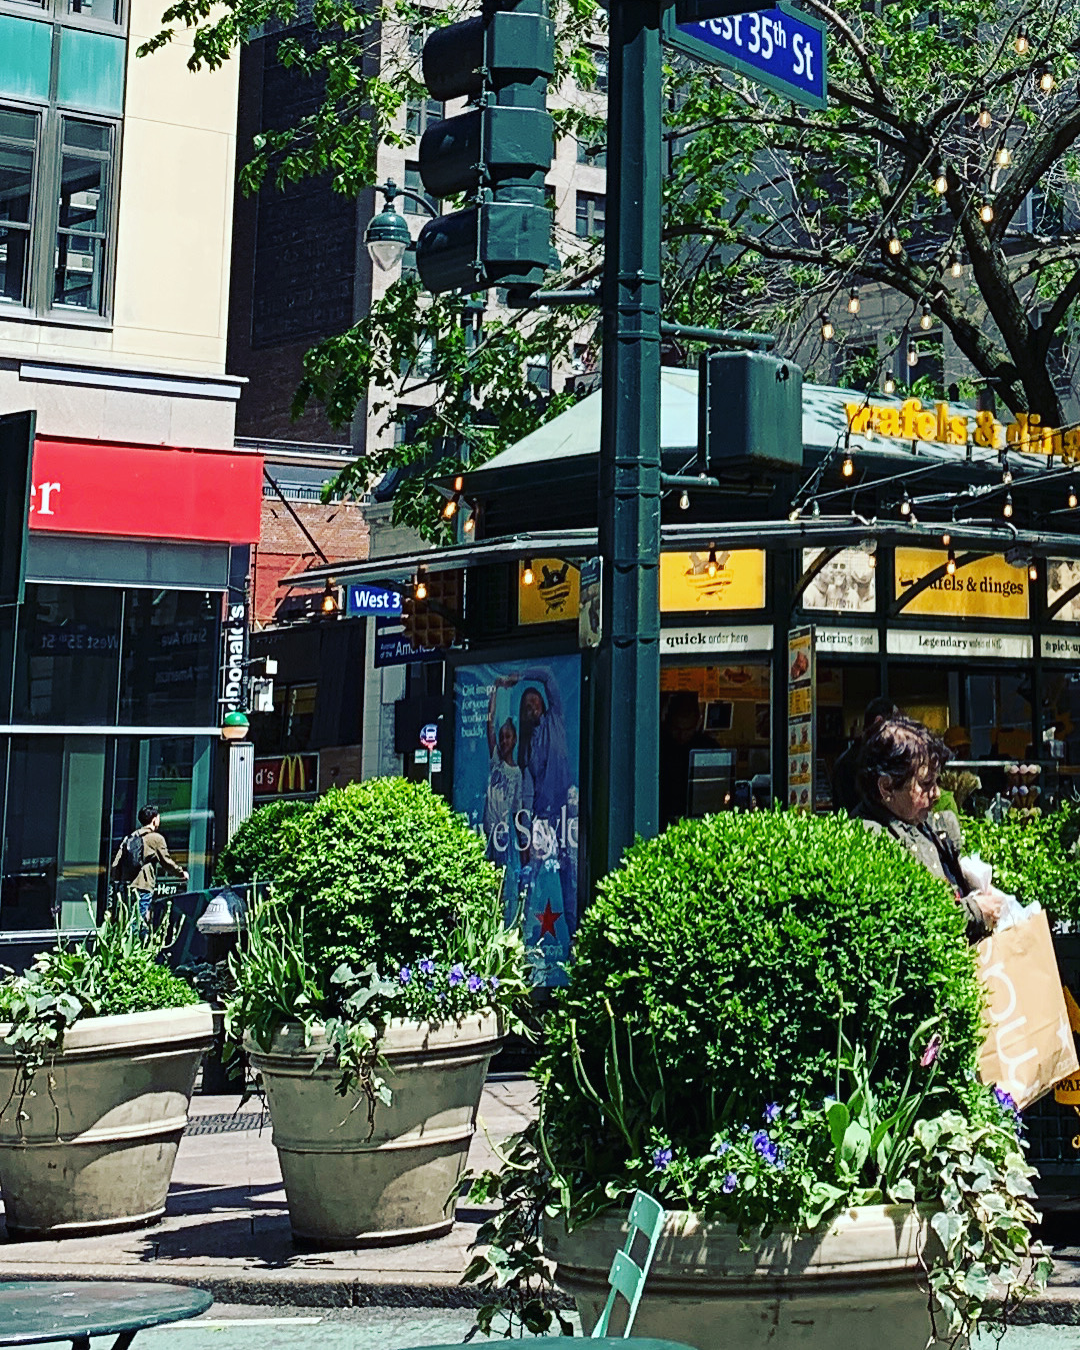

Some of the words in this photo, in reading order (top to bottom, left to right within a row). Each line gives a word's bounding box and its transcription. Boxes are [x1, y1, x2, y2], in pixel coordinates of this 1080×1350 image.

[698, 12, 743, 47] est
[747, 12, 787, 60] 35th
[792, 33, 814, 81] St
[843, 397, 968, 445] wafels
[971, 410, 1002, 450] &
[966, 578, 977, 593] &
[979, 576, 1025, 598] dinges
[354, 590, 390, 608] West
[666, 633, 707, 648] quick
[815, 631, 853, 646] rdering
[918, 635, 968, 650] Legendary
